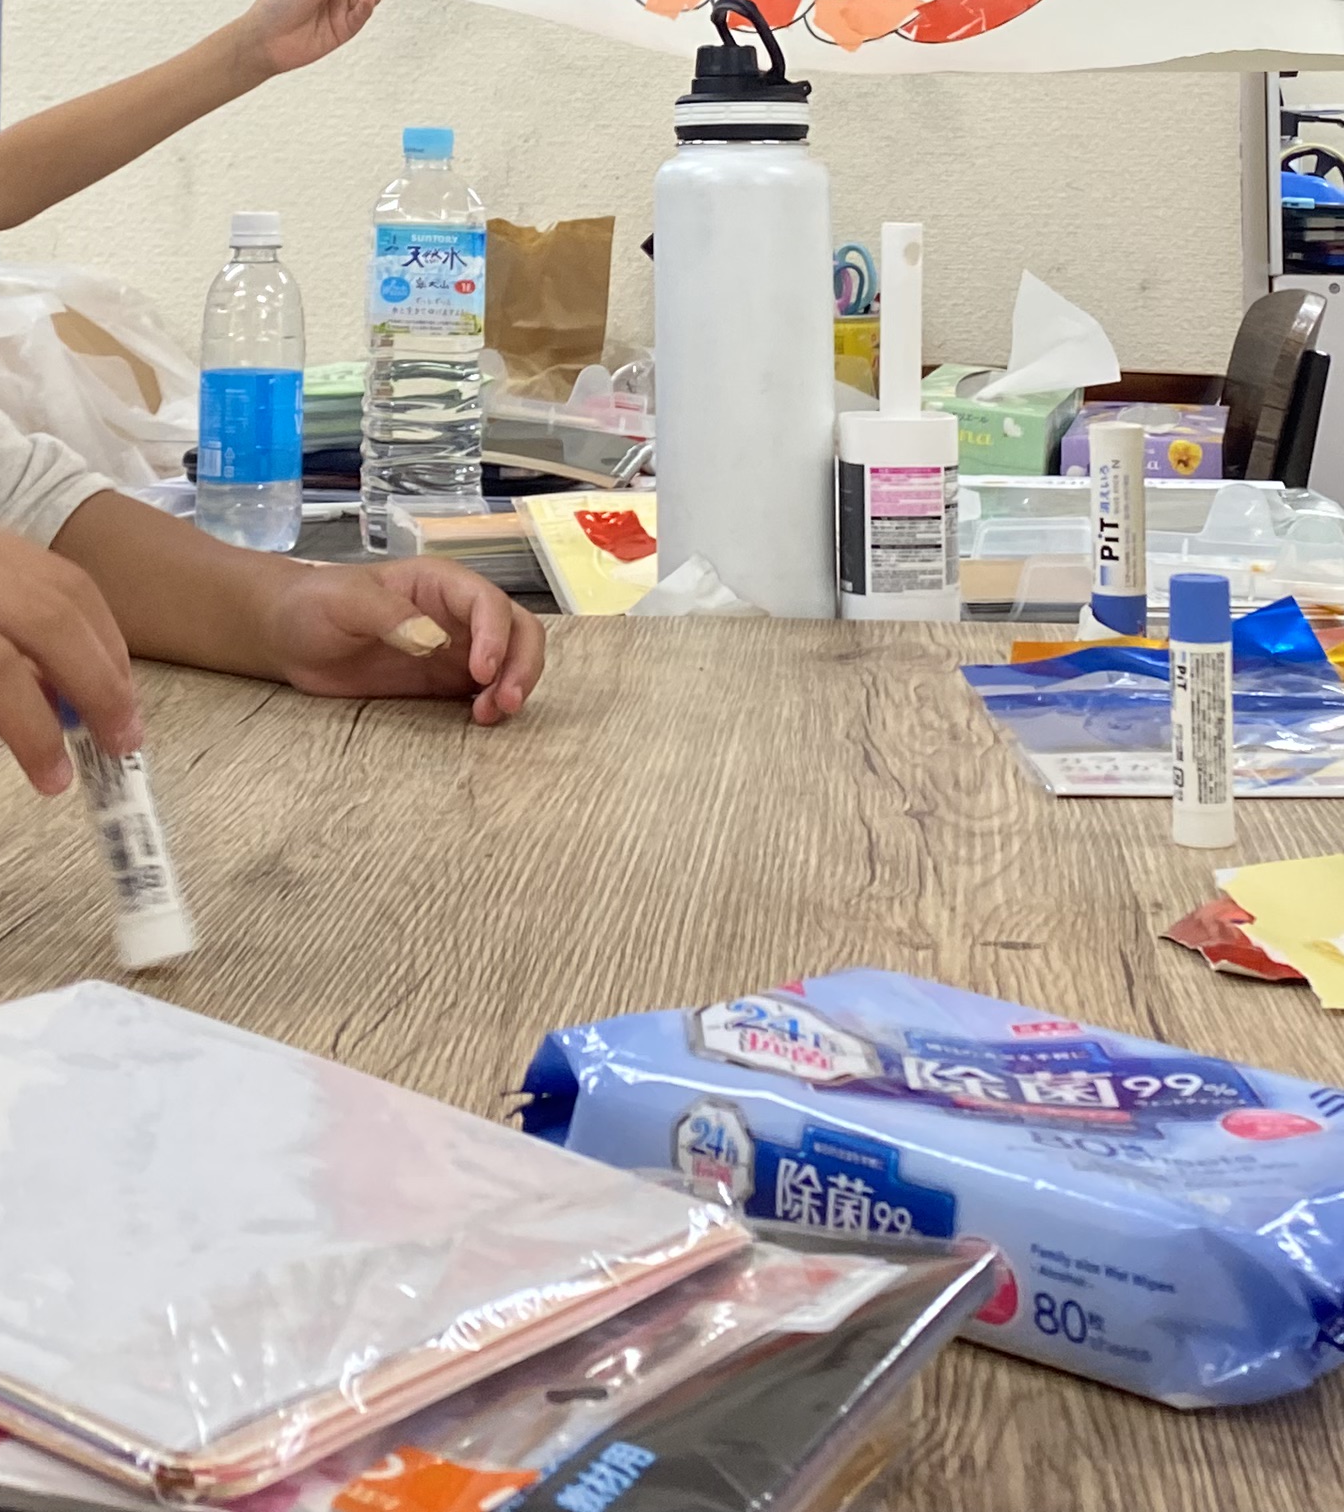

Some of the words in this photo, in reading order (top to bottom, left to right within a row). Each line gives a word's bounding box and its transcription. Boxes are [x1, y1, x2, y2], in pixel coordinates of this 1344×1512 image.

[411, 234, 458, 243] SUNTORY
[401, 245, 468, 270] 天然水
[775, 1157, 922, 1240] 除菌99
